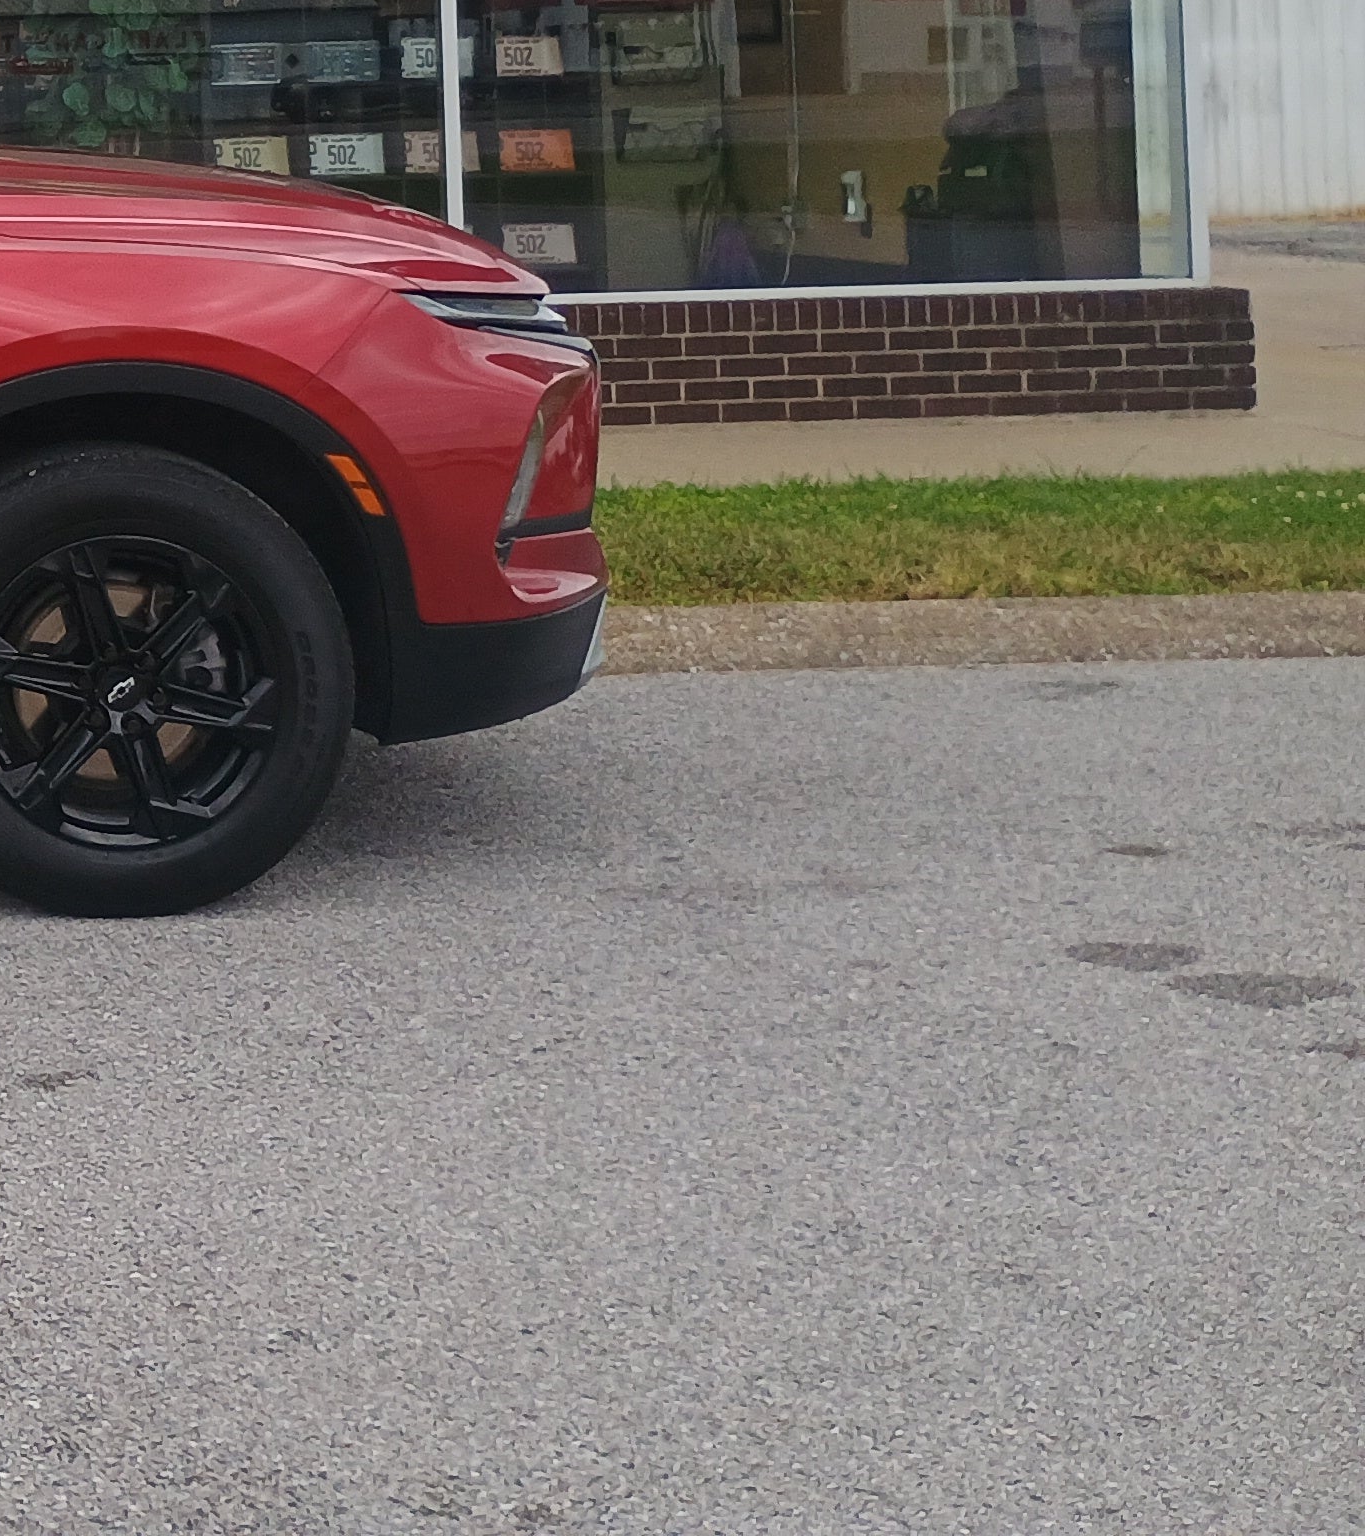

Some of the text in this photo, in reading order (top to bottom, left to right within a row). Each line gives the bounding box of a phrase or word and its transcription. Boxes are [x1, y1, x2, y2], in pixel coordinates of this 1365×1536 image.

[415, 47, 435, 68] 50
[503, 46, 535, 67] 502
[232, 146, 262, 168] 502
[327, 144, 357, 165] 502
[421, 142, 440, 163] 50
[515, 141, 545, 162] 502
[515, 233, 547, 255] 502
